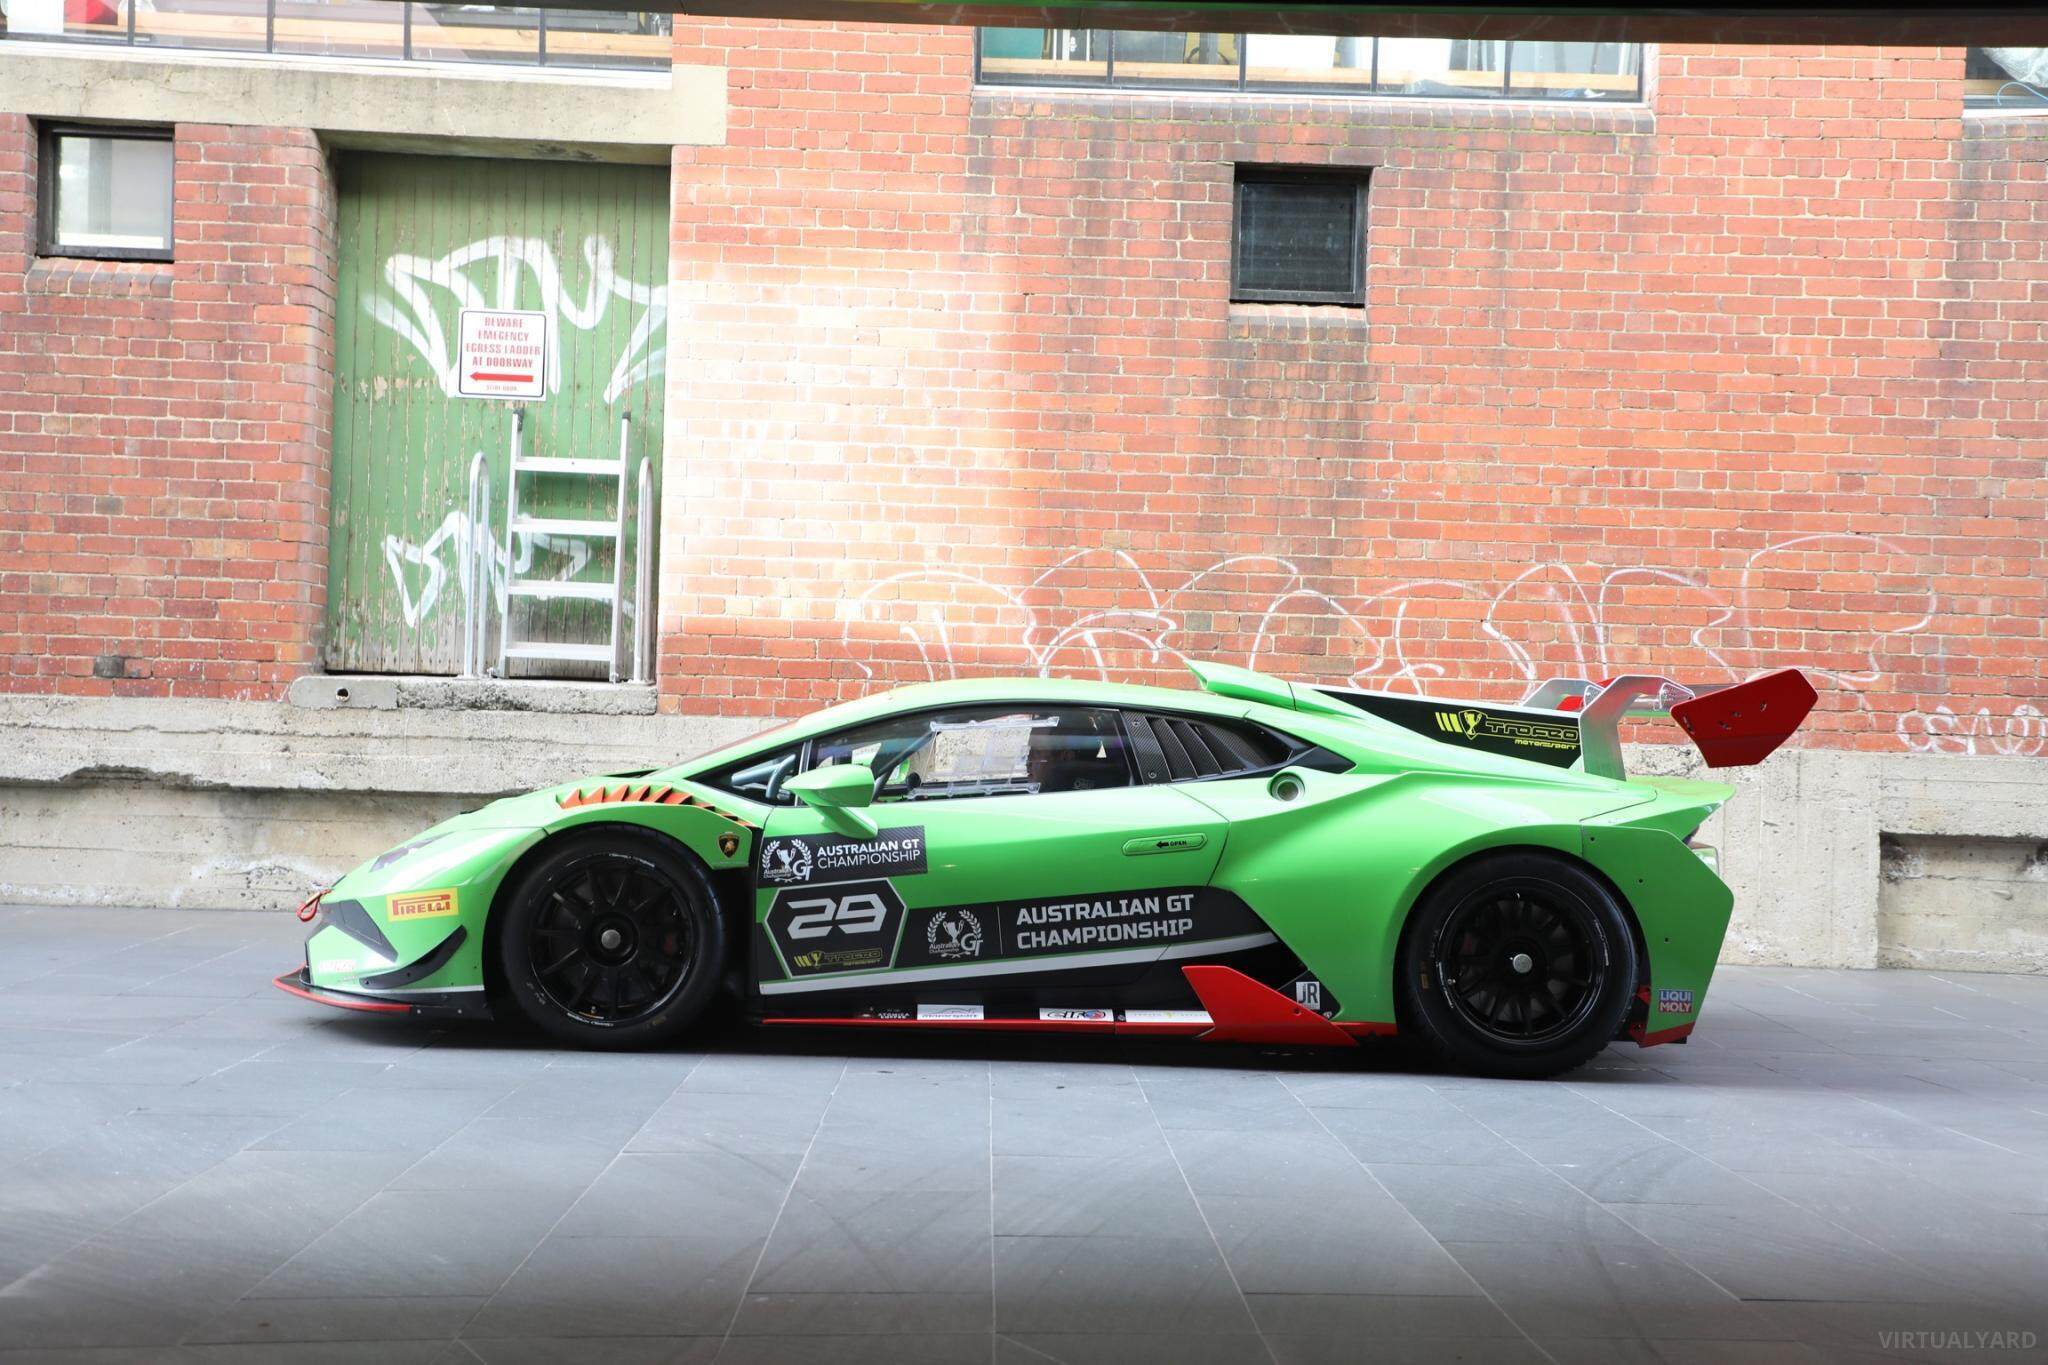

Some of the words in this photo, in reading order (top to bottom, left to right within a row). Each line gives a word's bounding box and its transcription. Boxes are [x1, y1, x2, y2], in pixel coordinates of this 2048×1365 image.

[484, 316, 524, 329] BEWARE
[465, 342, 502, 354] EGRESS
[504, 344, 541, 356] LADDER
[472, 356, 483, 367] AT
[486, 357, 534, 369] DOORWAY
[816, 840, 899, 858] AUSTRALIAN
[902, 838, 920, 850] GT
[817, 849, 921, 869] CHAMPIONSHIP
[392, 893, 451, 916] PIRELLI
[1016, 896, 1161, 926] AUSTRALIAN
[1166, 894, 1194, 913] GT
[786, 893, 887, 940] 29
[1016, 917, 1193, 950] CHAMPIONSHIP
[1660, 990, 1692, 1002] LIQUI
[1660, 1001, 1692, 1013] MOLY
